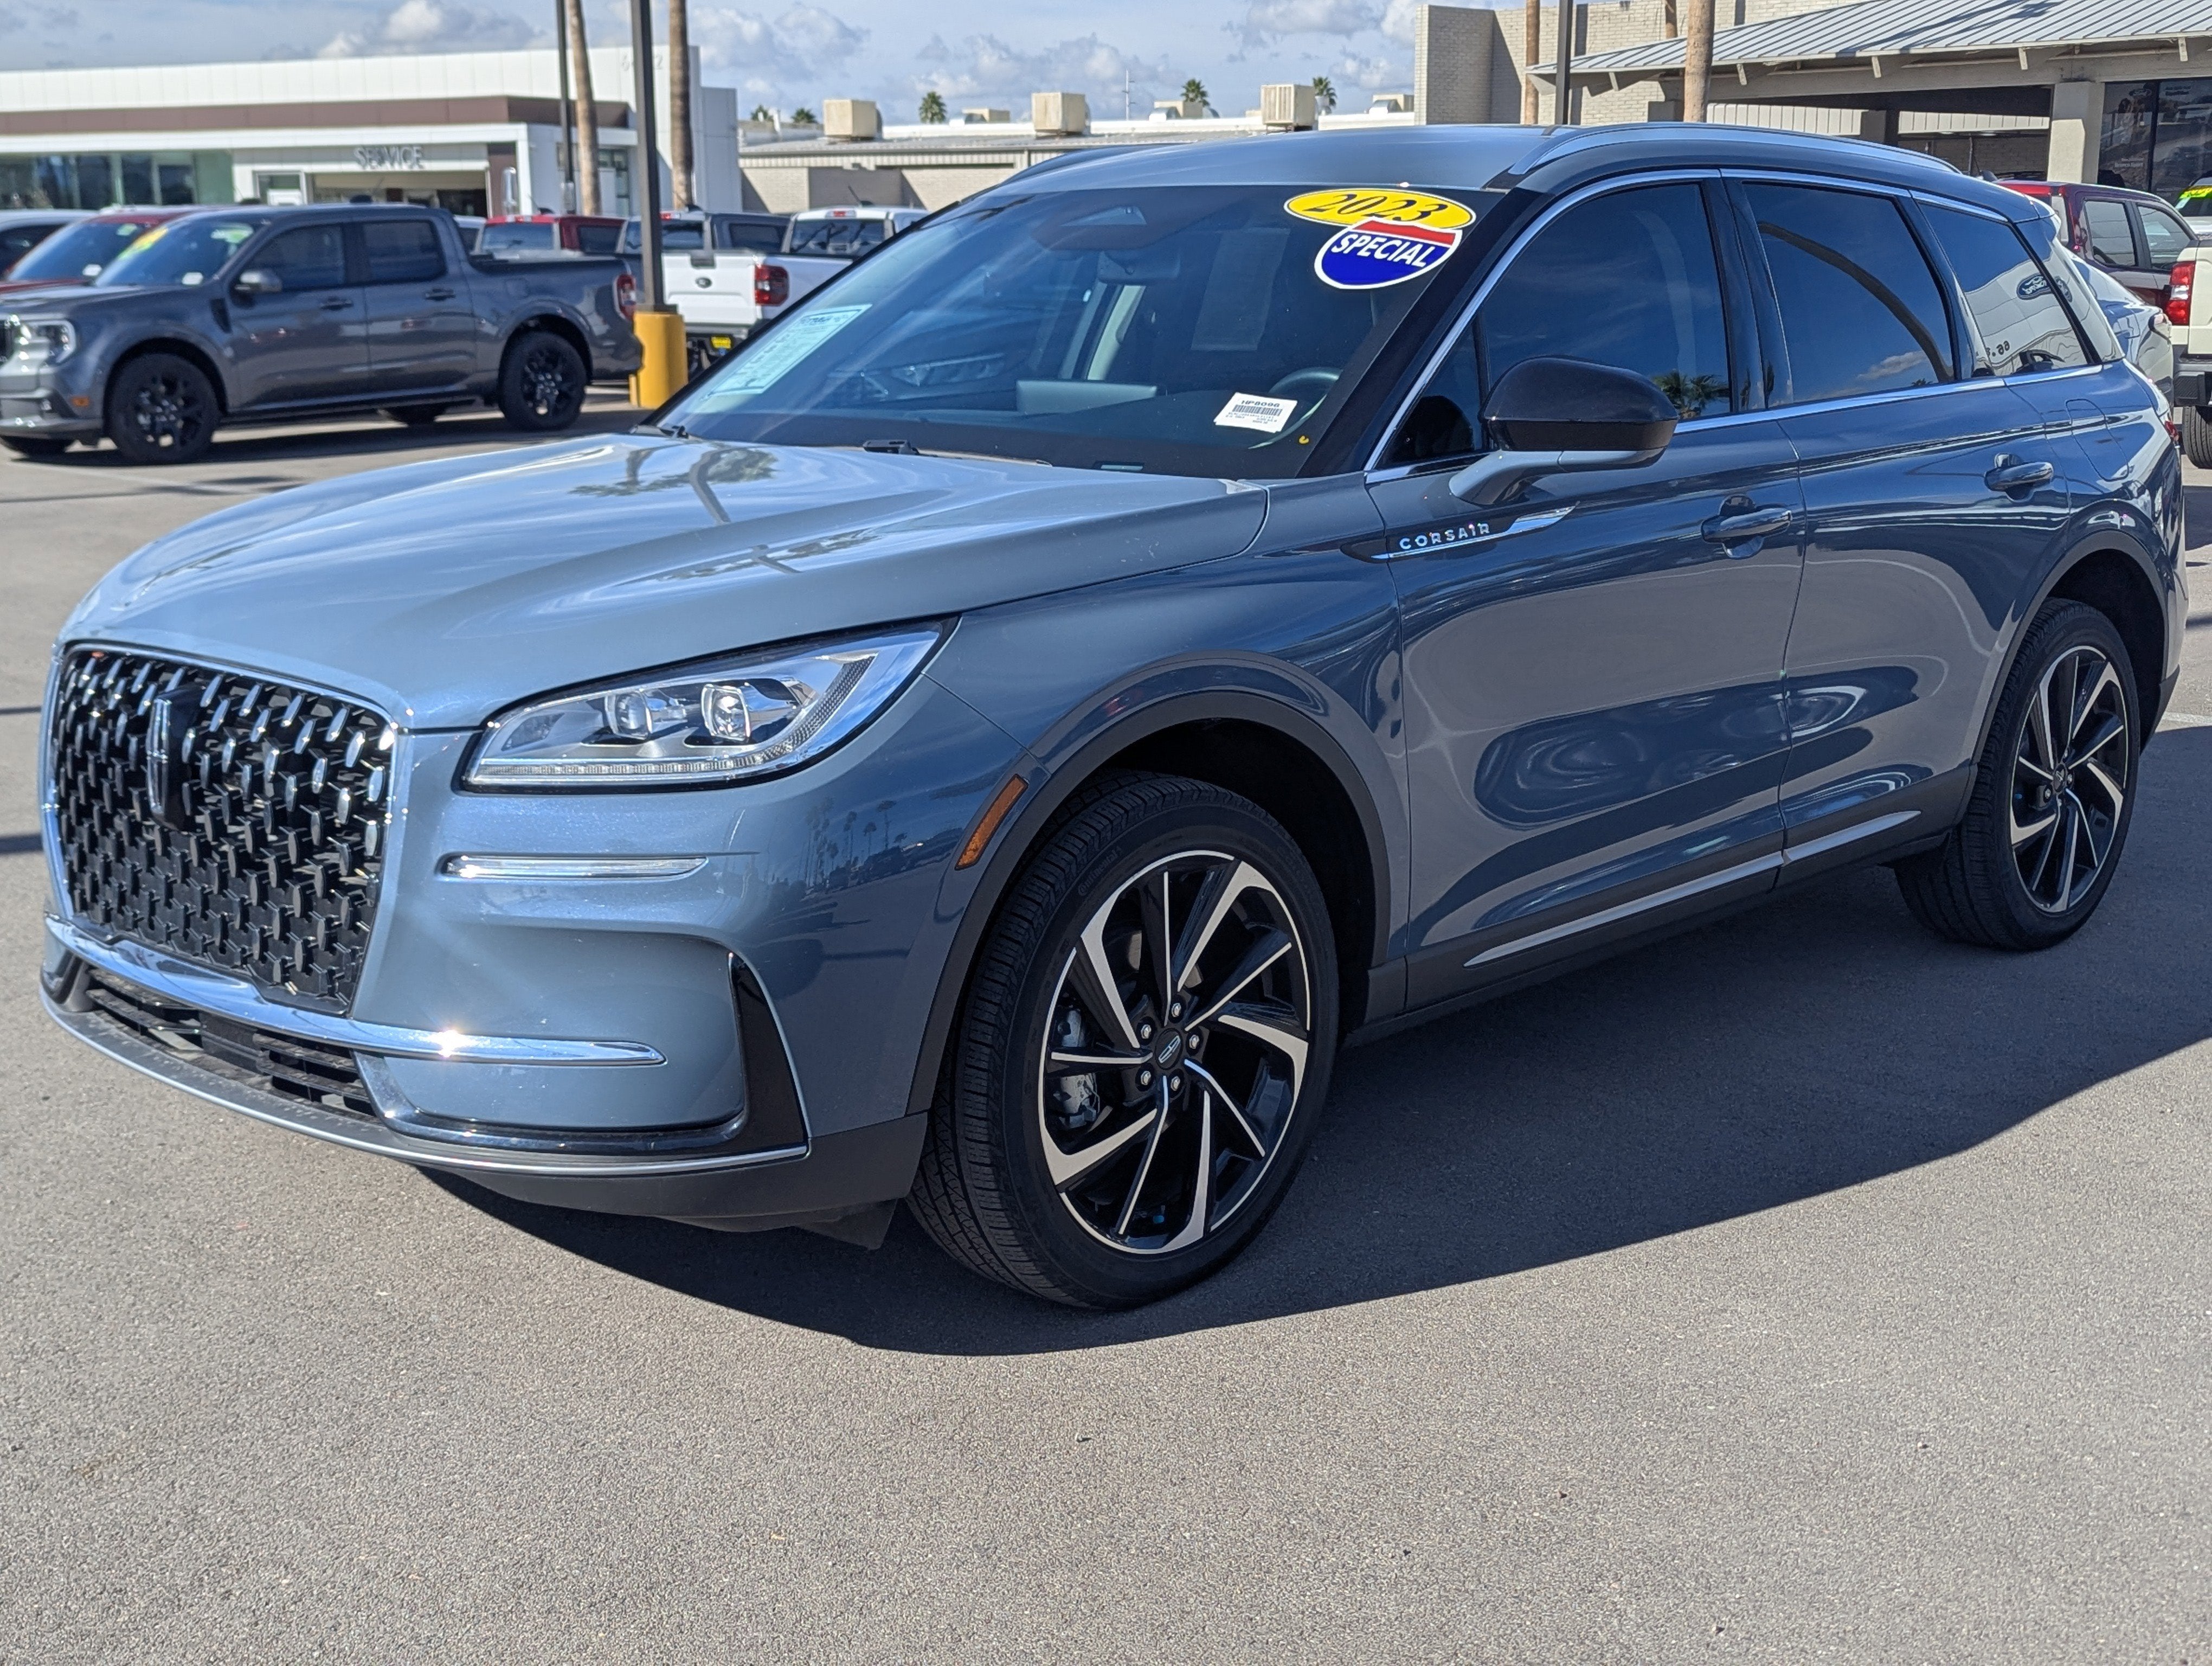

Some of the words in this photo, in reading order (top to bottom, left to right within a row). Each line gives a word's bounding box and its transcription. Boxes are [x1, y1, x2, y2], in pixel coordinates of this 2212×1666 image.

[354, 146, 423, 170] SERVICE
[1302, 194, 1449, 221] 2023
[1331, 234, 1436, 267] SPECIAL
[1399, 523, 1490, 550] CORSAIR
